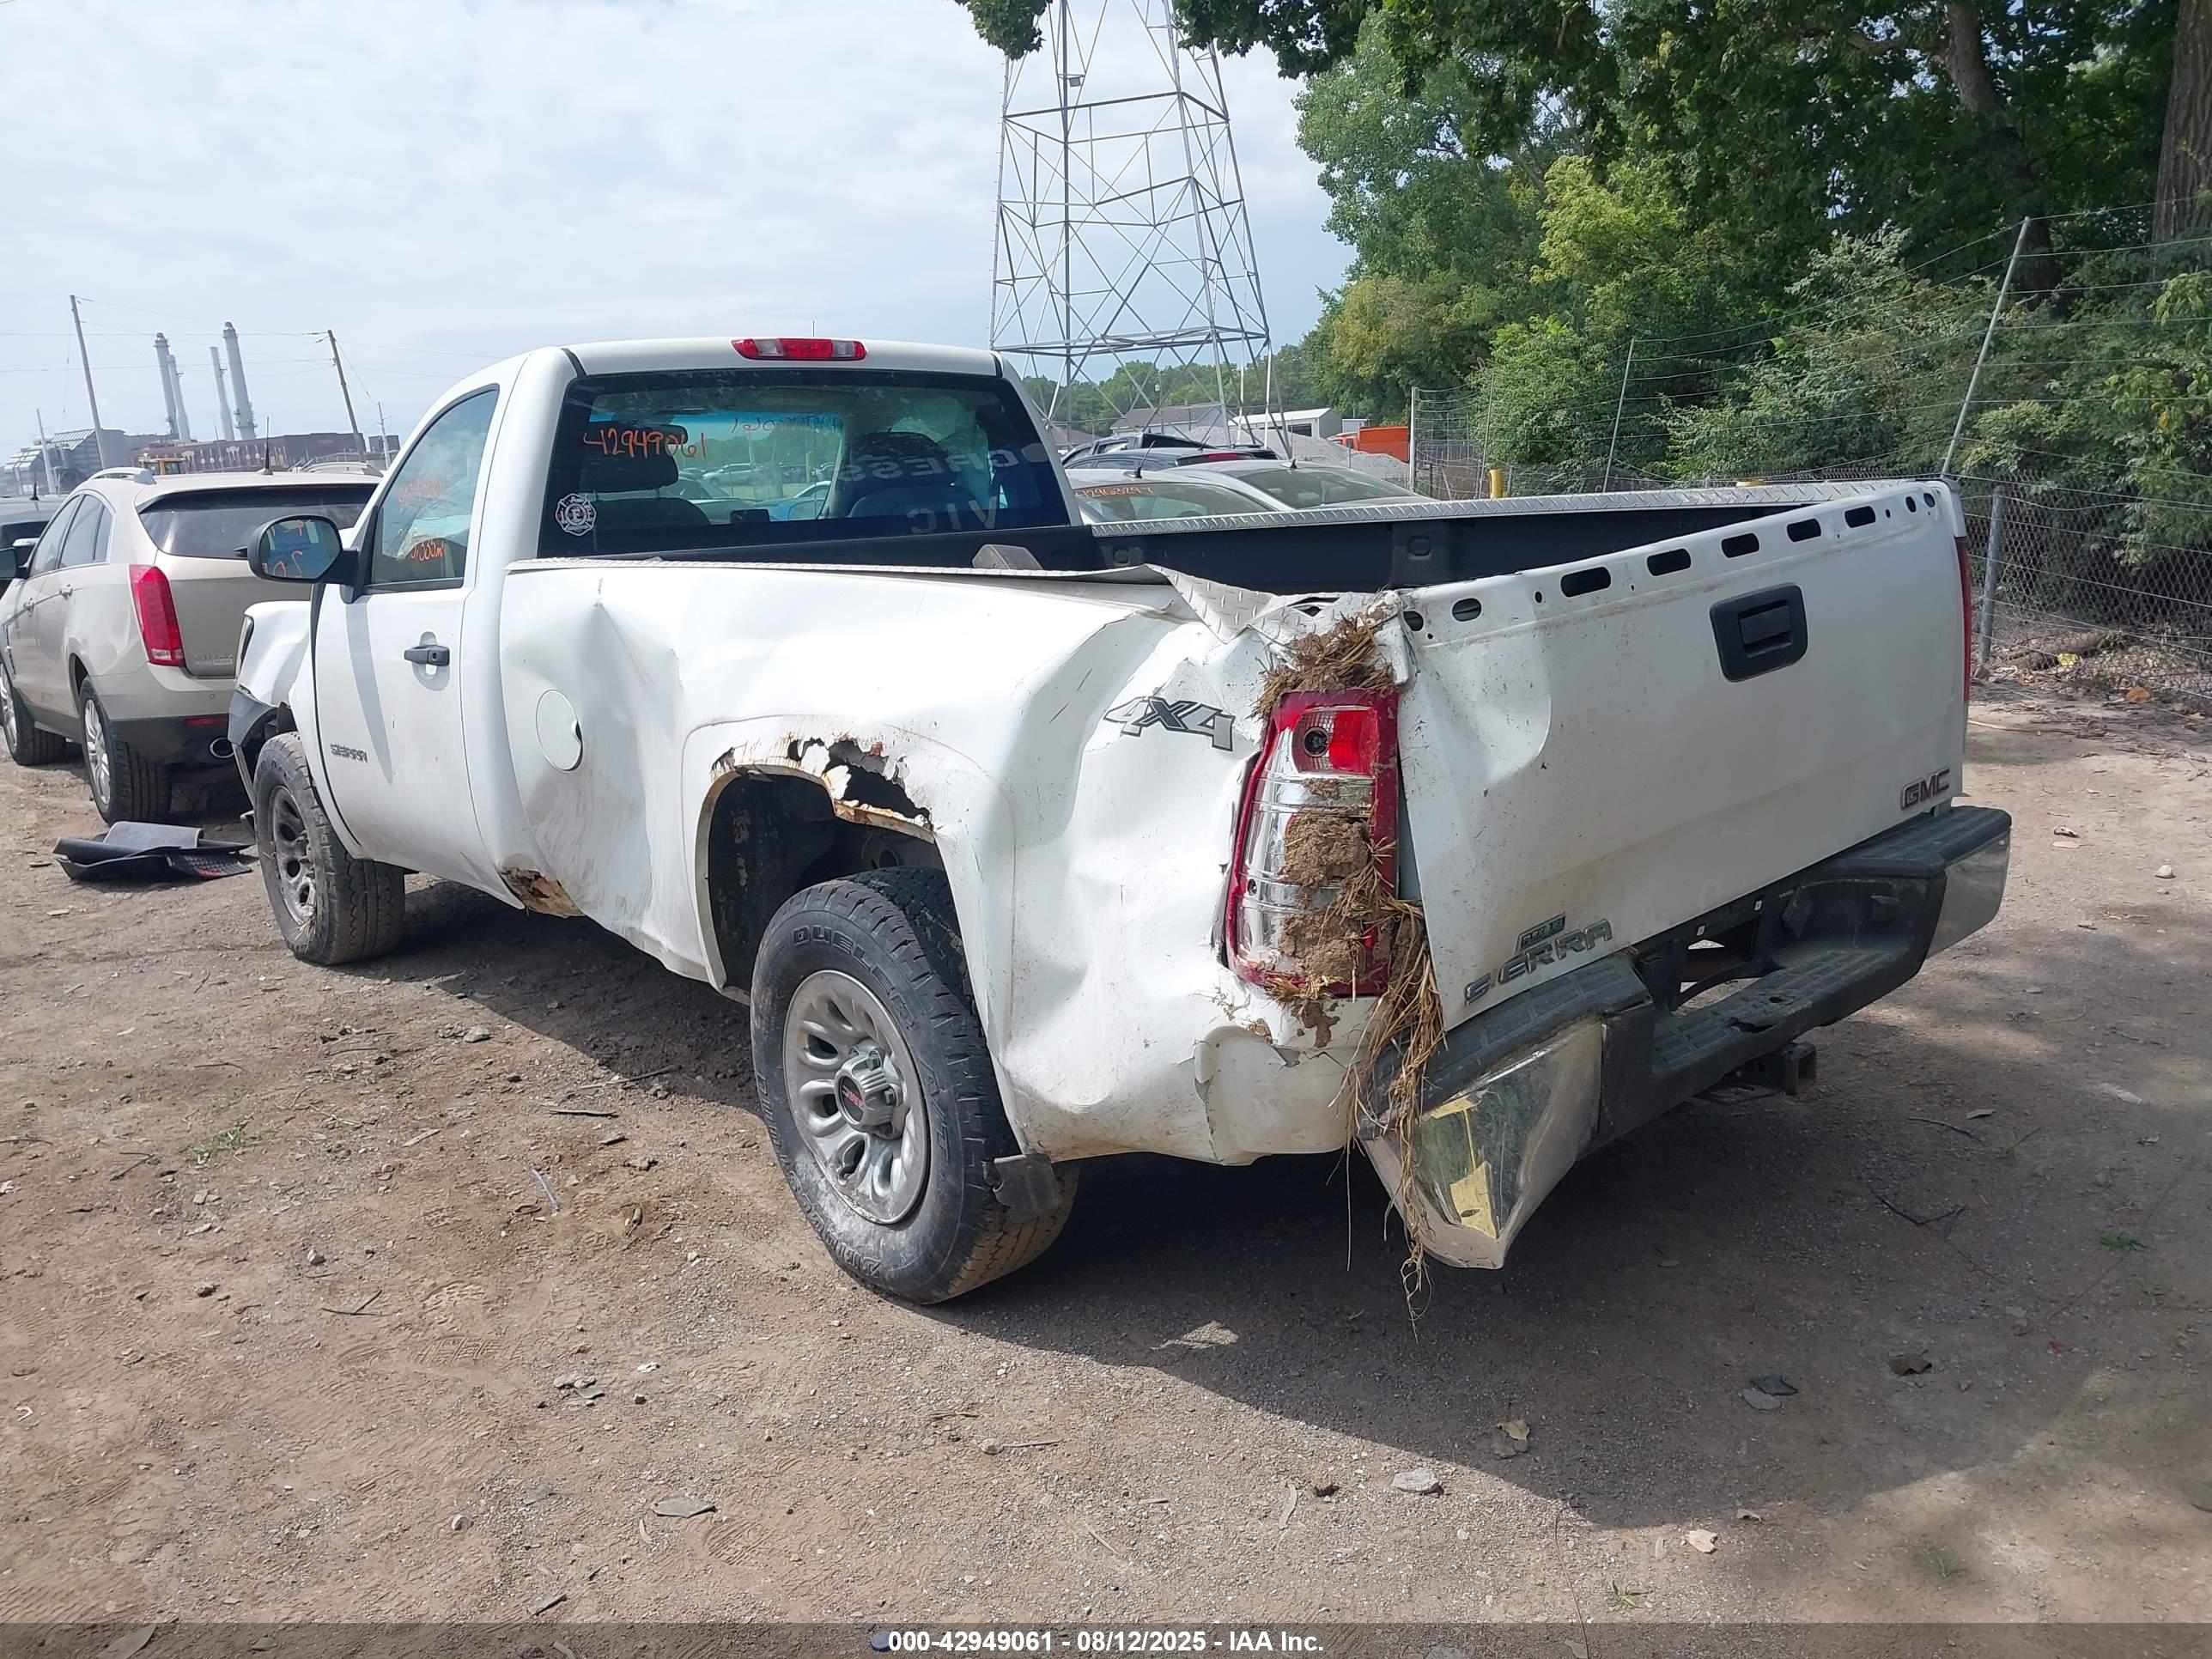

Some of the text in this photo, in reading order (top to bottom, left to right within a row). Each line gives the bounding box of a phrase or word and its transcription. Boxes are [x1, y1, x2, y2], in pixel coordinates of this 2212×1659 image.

[583, 428, 707, 459] 42949061
[330, 742, 368, 763] SIERRA
[1900, 768, 1950, 811] GMC
[792, 924, 915, 1030] DUELER
[1463, 918, 1613, 1006] SERRA
